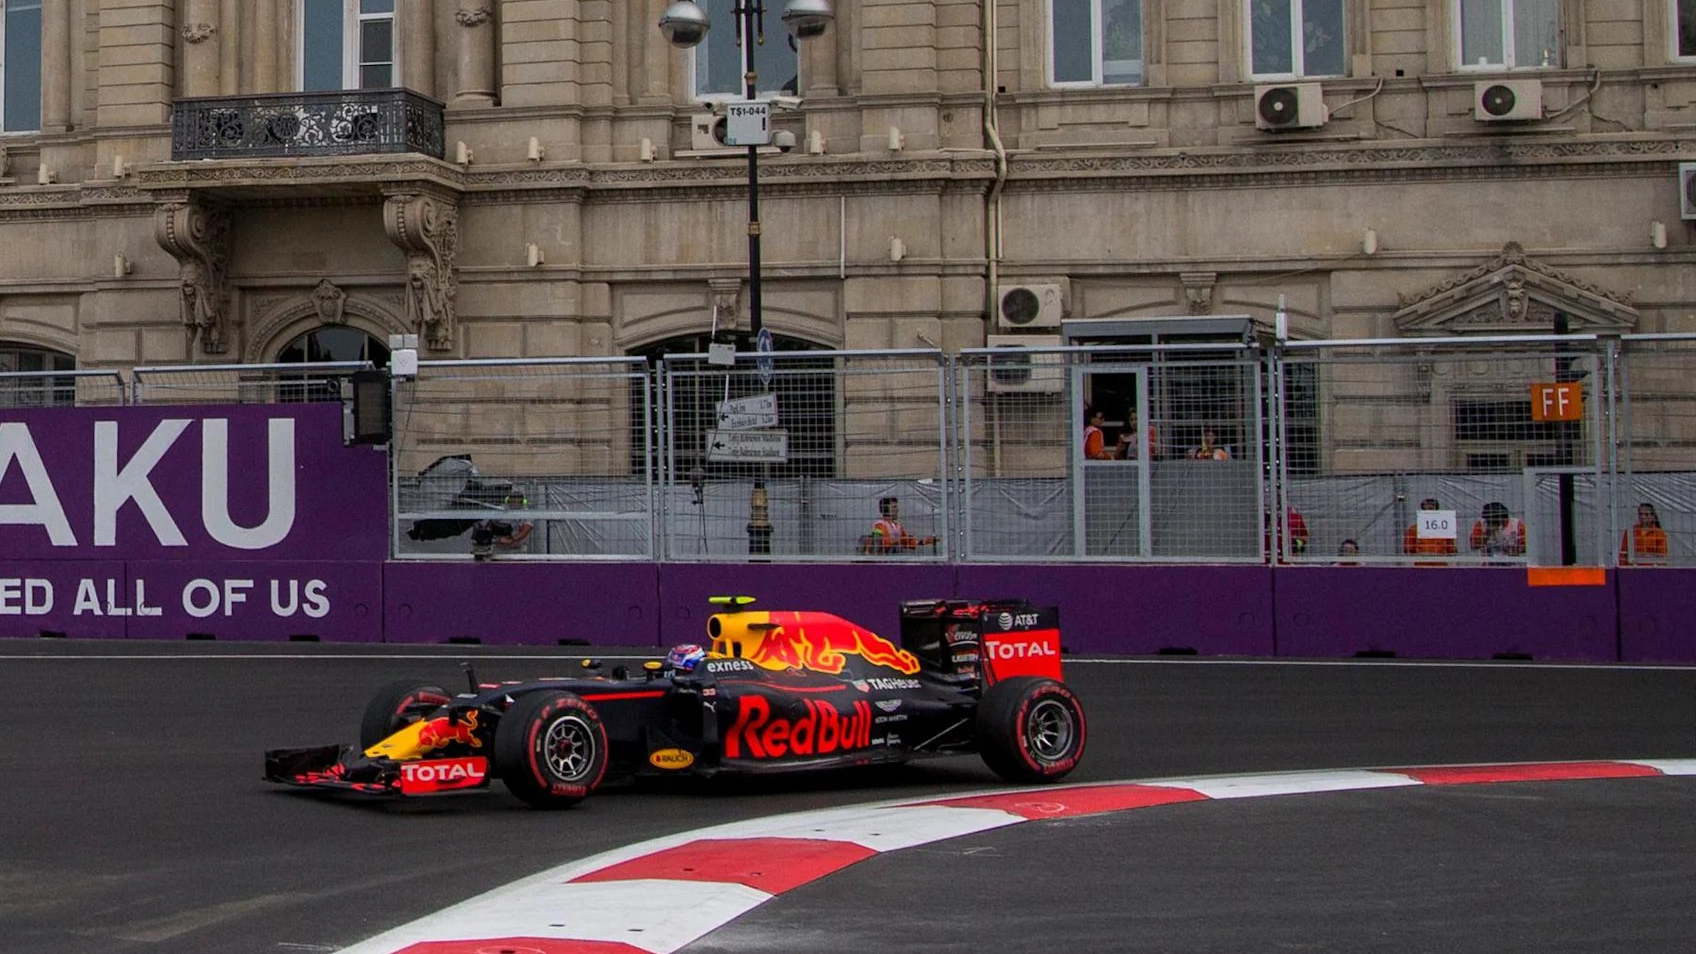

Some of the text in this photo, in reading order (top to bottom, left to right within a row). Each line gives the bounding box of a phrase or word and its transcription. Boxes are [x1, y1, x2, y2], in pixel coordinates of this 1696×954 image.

[730, 107, 766, 117] TS1-044
[1542, 387, 1570, 417] FF
[1425, 520, 1448, 530] 16.0
[74, 578, 163, 617] ALL
[182, 578, 254, 618] OF
[271, 579, 331, 619] US
[1015, 613, 1039, 626] AT&T
[985, 641, 1056, 660] TOTAL
[707, 660, 754, 673] exness
[402, 762, 485, 782] TOTAL
